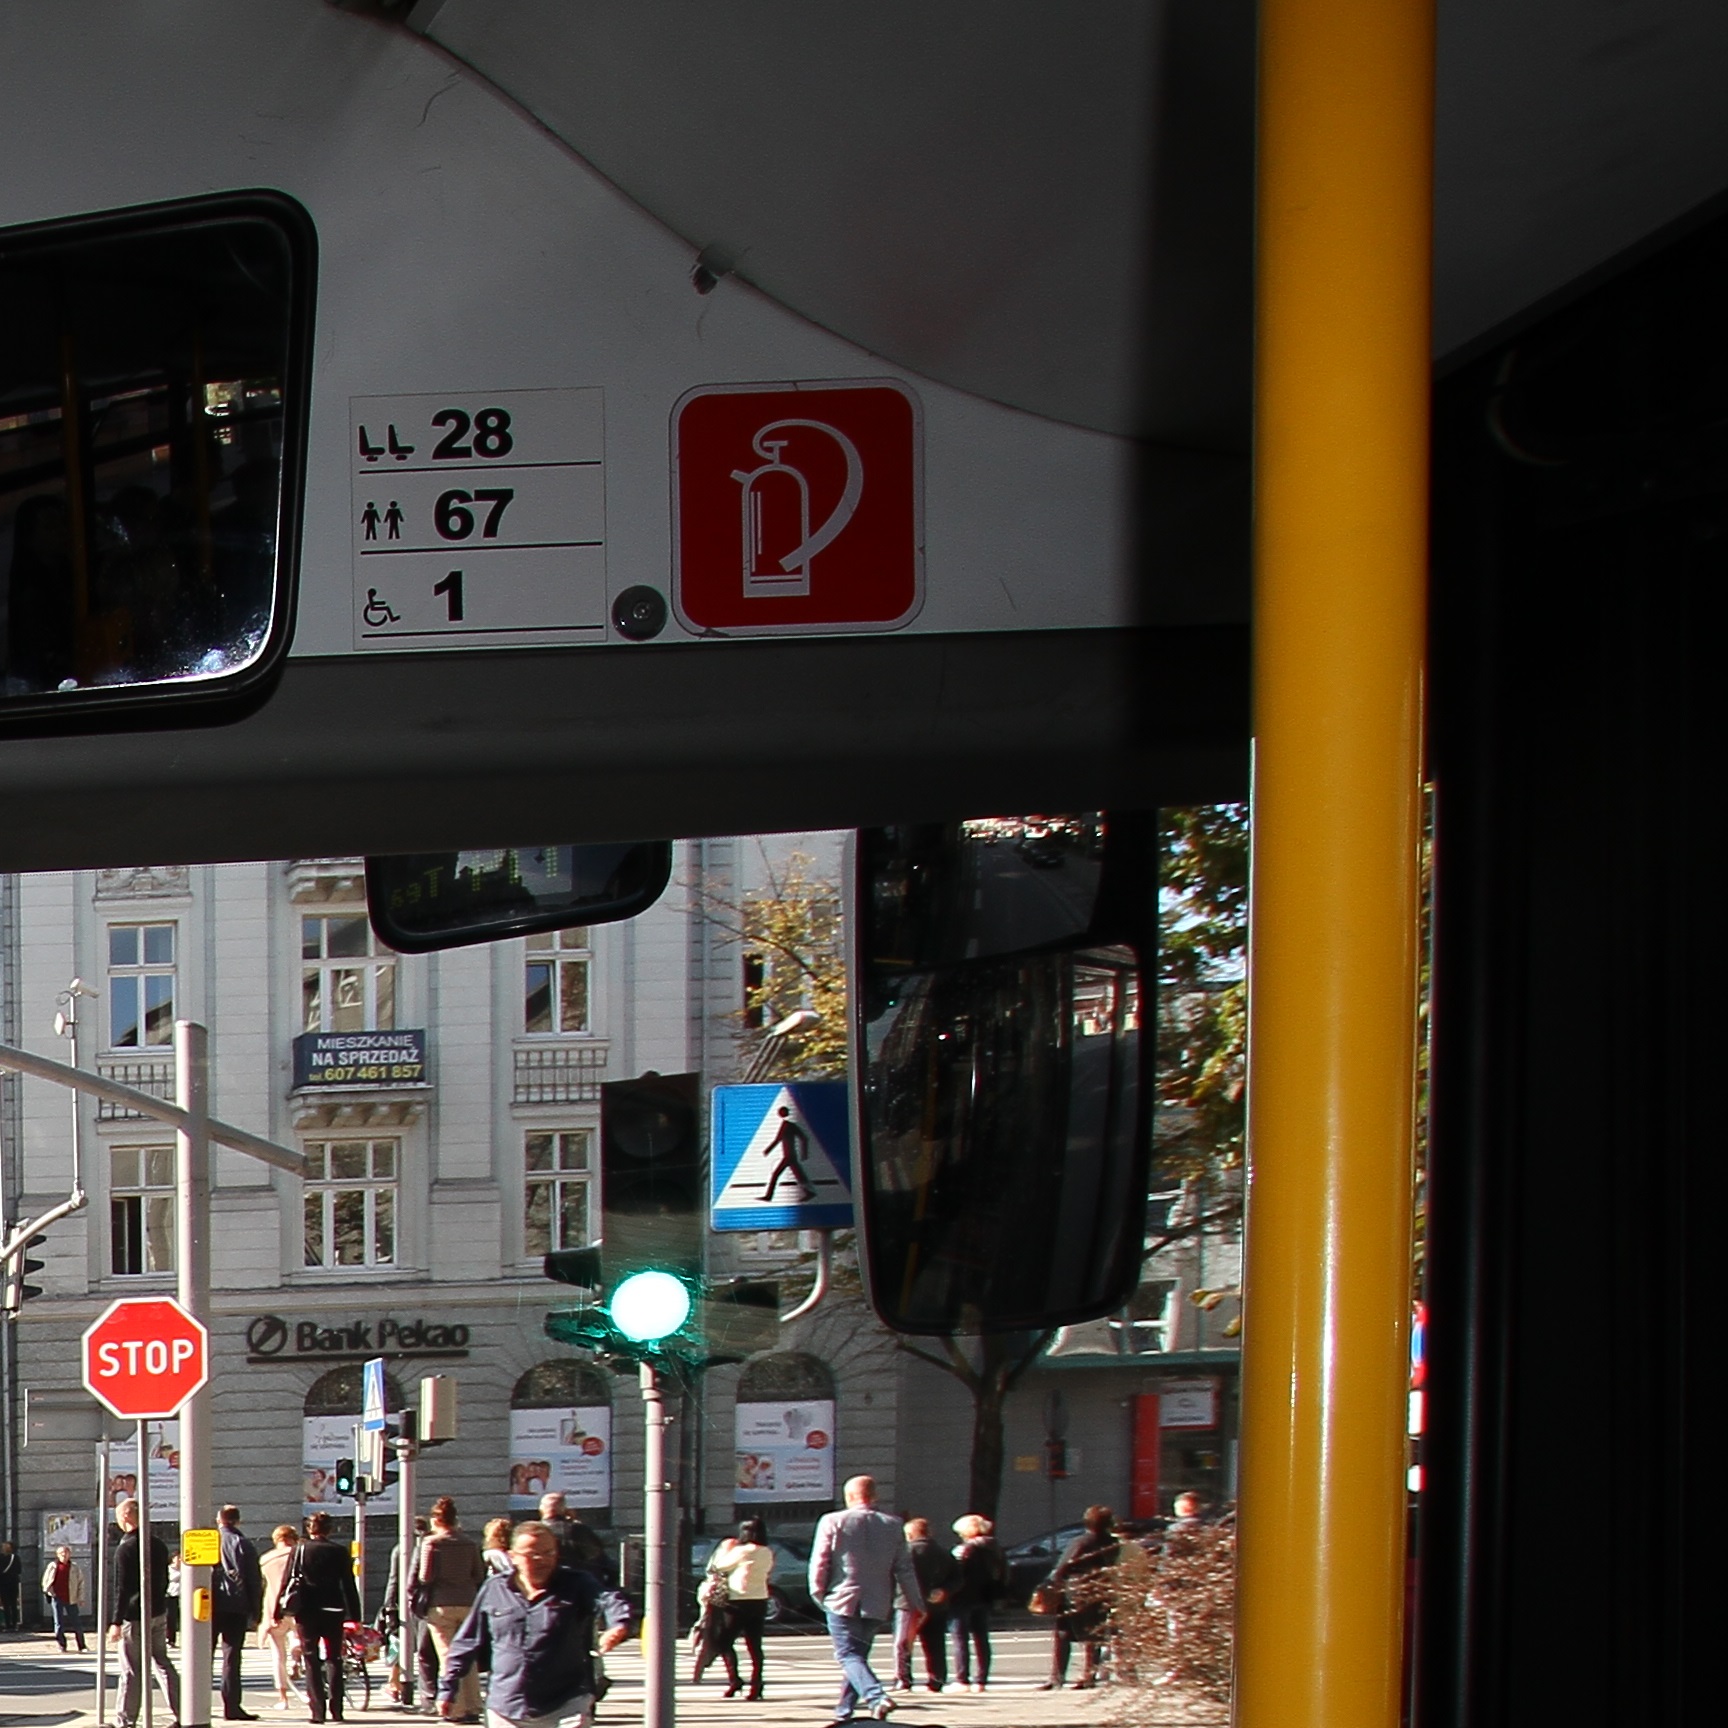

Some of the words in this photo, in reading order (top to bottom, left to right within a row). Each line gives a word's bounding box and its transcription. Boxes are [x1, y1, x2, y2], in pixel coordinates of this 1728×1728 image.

[430, 407, 513, 460] 28
[433, 488, 515, 542] 67
[433, 570, 463, 622] 1
[312, 1053, 335, 1066] NA
[338, 1046, 419, 1066] SPRZEDAŻ
[317, 1035, 413, 1049] MIESZKANIE
[324, 1067, 356, 1081] 607
[357, 1066, 387, 1079] 461
[391, 1064, 424, 1079] 857
[296, 1320, 373, 1352] Bank
[378, 1319, 470, 1351] Pekao
[98, 1338, 195, 1378] STOP
